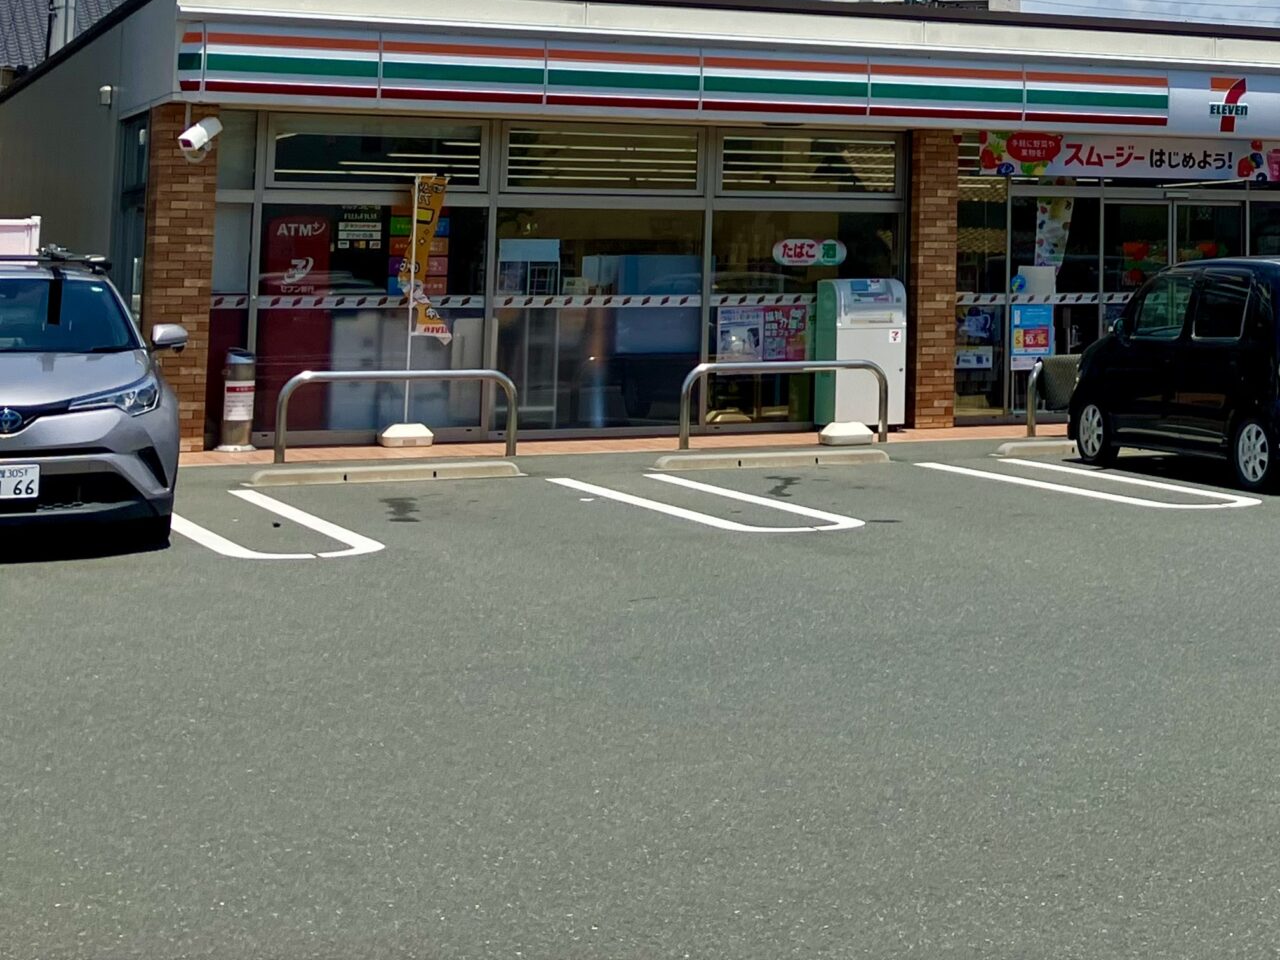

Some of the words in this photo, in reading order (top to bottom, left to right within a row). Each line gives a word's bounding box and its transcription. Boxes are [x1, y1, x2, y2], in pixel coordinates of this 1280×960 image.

[1064, 143, 1145, 168] スムージー
[277, 223, 313, 237] ATM
[781, 242, 817, 259] たばこ
